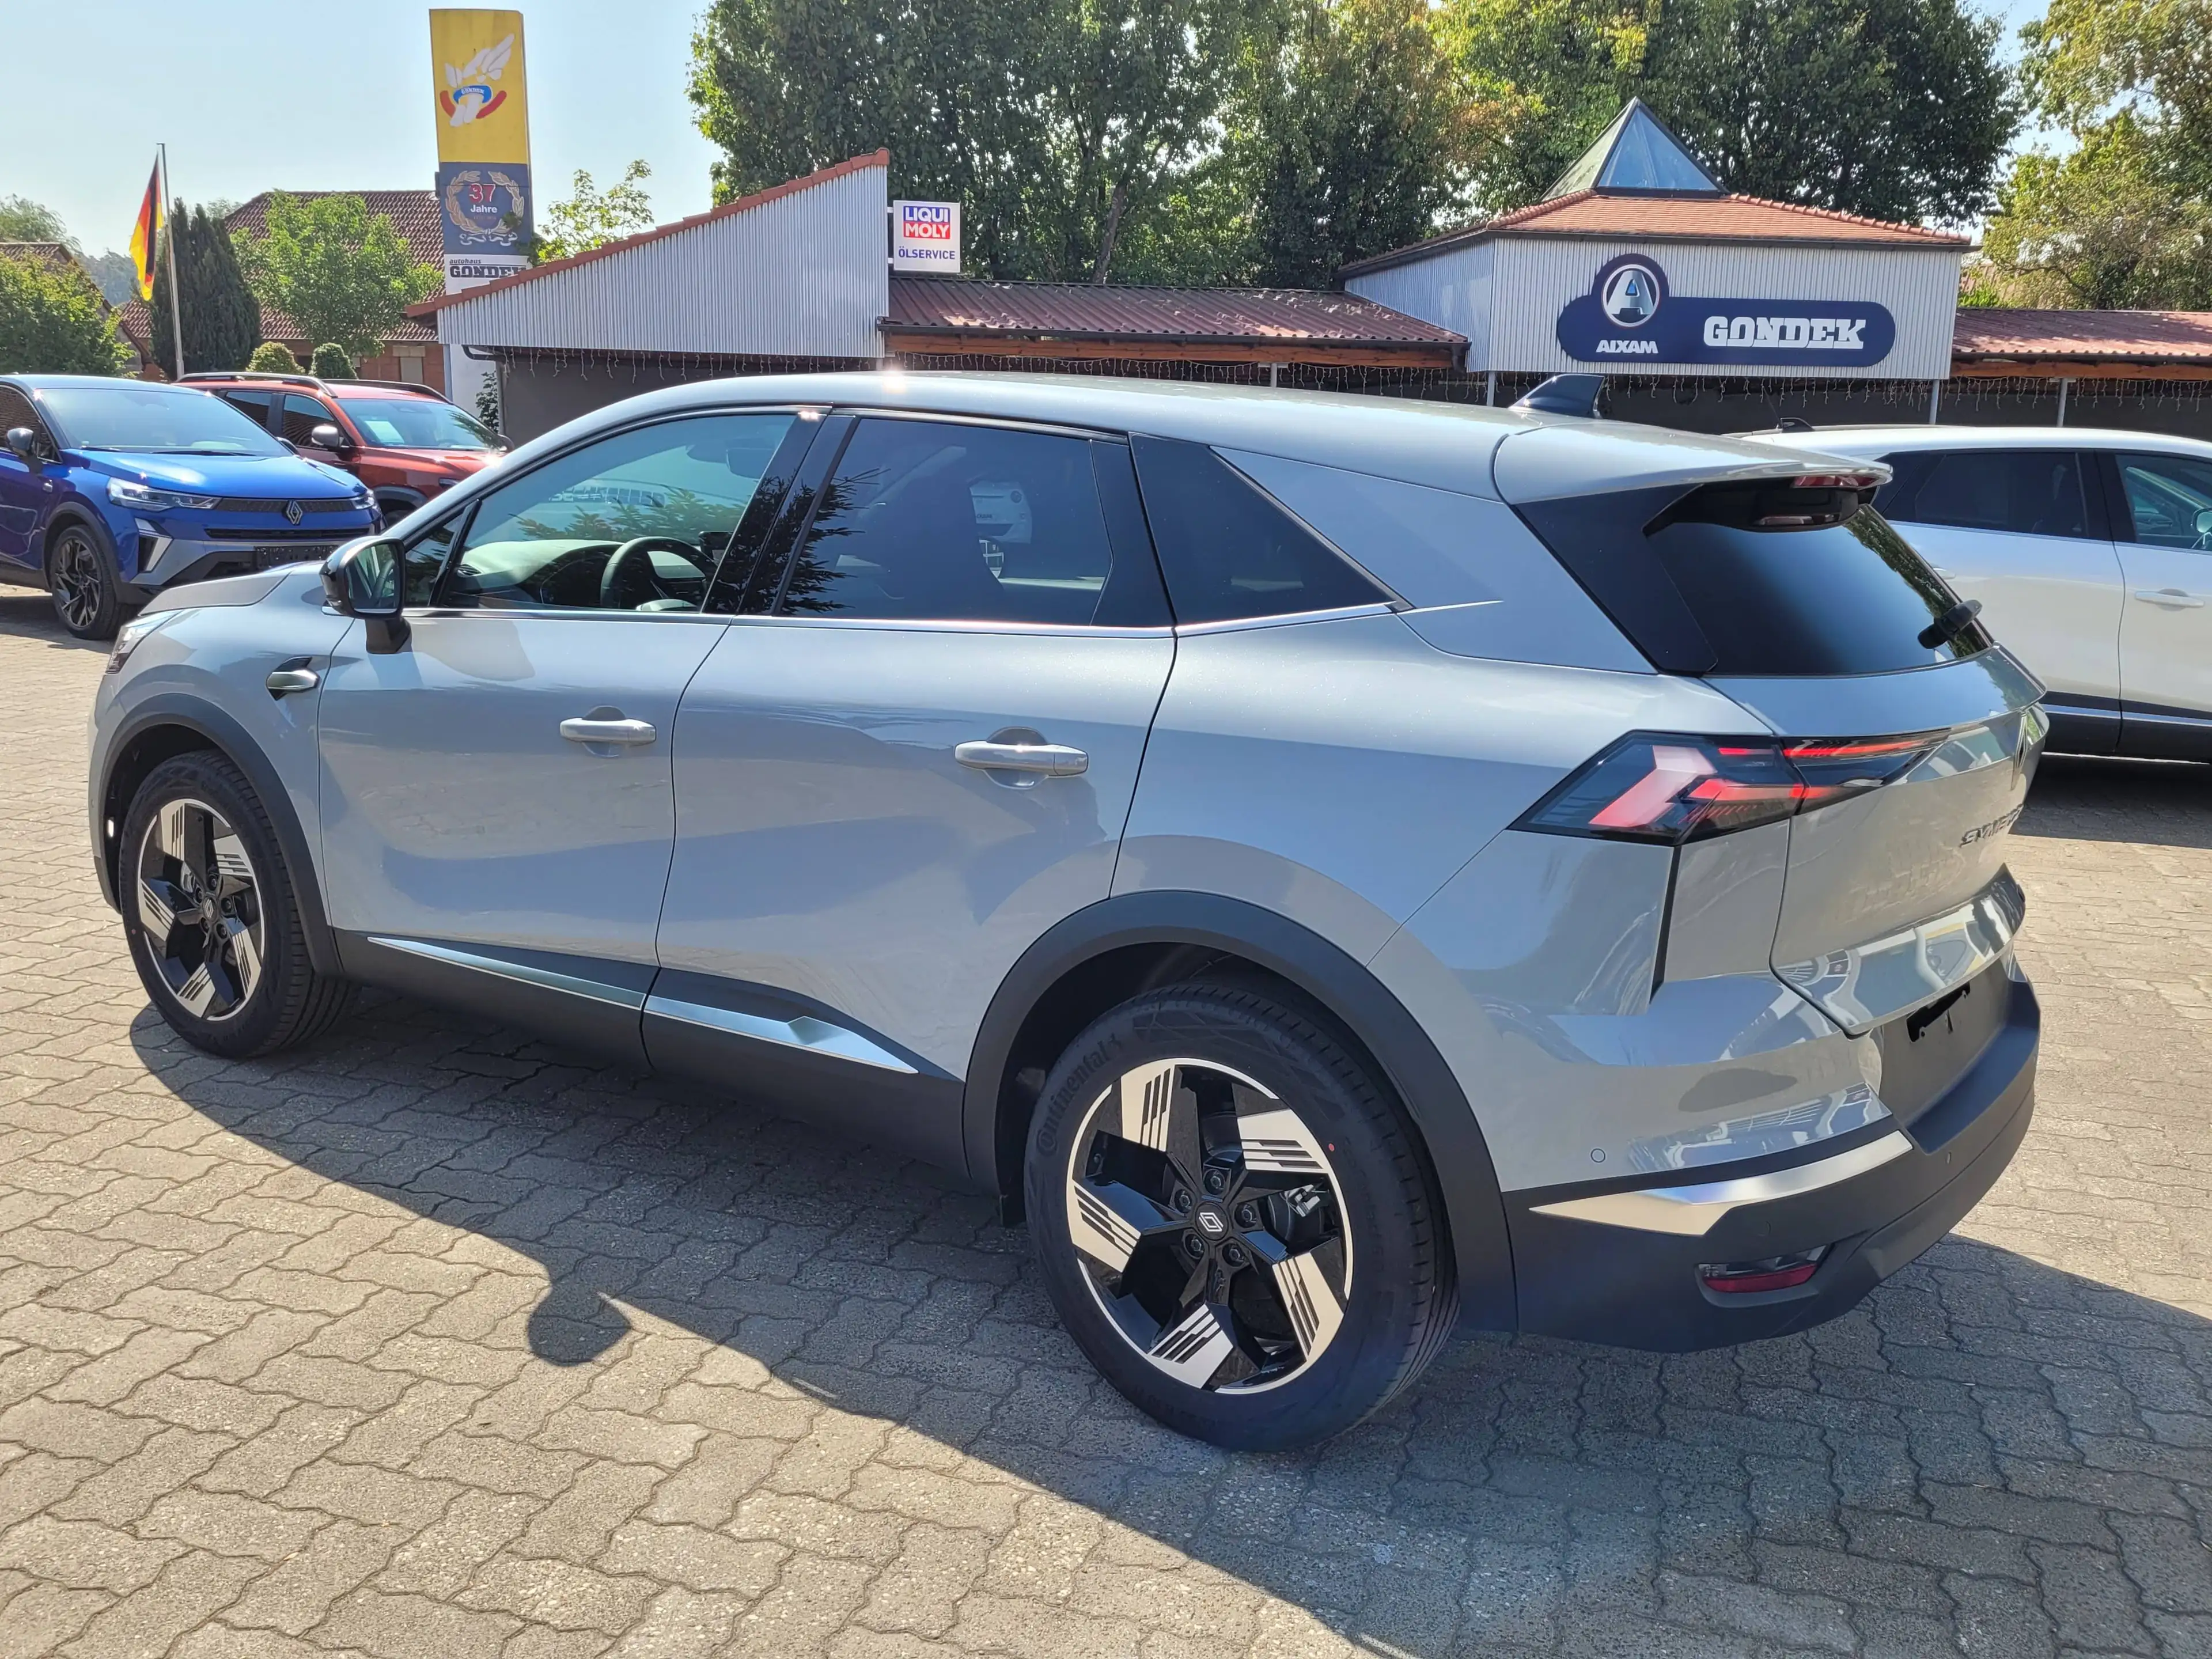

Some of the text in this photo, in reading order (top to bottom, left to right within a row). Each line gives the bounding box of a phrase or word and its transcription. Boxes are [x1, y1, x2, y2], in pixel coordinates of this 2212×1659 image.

[468, 183, 495, 203] 37
[470, 204, 498, 213] Jahre
[905, 207, 949, 222] LIQUI
[905, 223, 949, 238] MOLY
[898, 246, 956, 260] ÖLSERVICE
[1703, 316, 1866, 349] GONDEK
[1596, 339, 1659, 354] AIXAM
[1036, 1039, 1112, 1157] Continental
